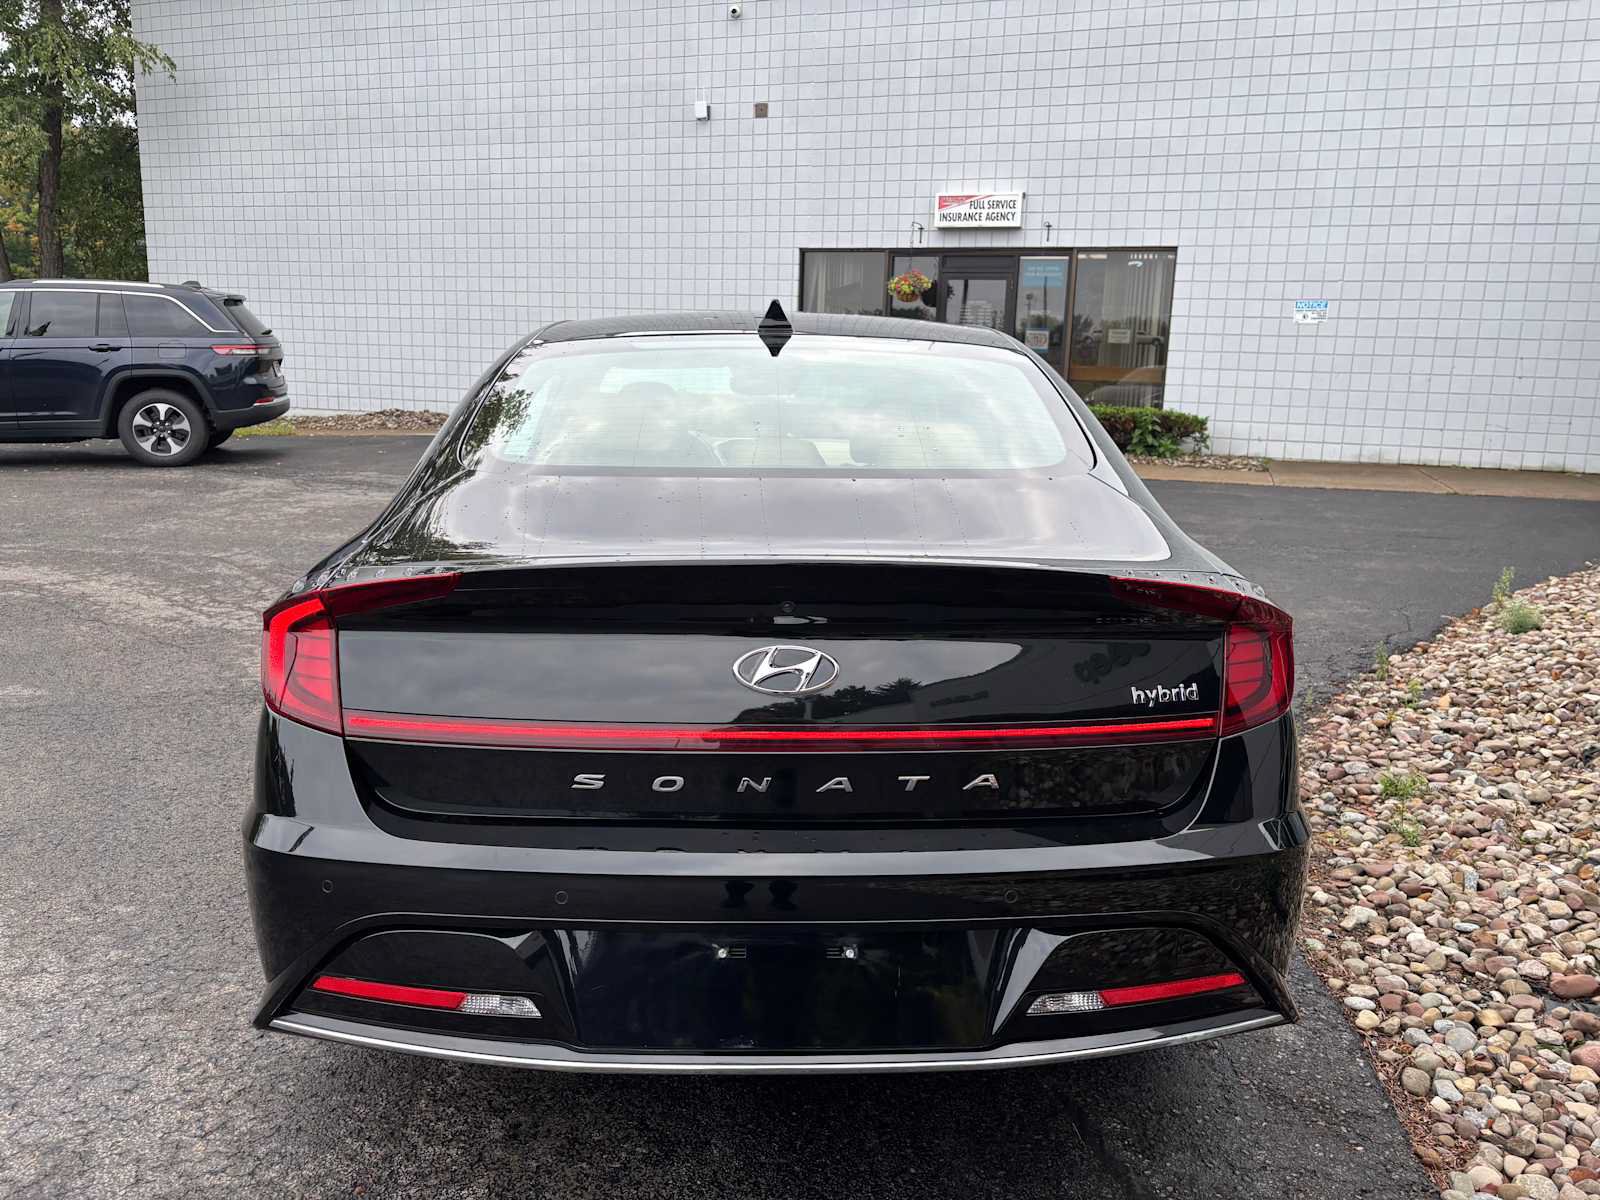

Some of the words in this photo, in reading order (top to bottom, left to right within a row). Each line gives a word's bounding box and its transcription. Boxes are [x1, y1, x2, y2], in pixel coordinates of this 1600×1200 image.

[969, 200, 985, 209] FULL
[987, 200, 1016, 209] SERVICE
[940, 212, 982, 222] INSURANCE
[985, 212, 1016, 221] AGENCY
[1296, 301, 1327, 309] NOTICE
[1131, 683, 1199, 707] hybrid
[571, 774, 1000, 792] SONATA
